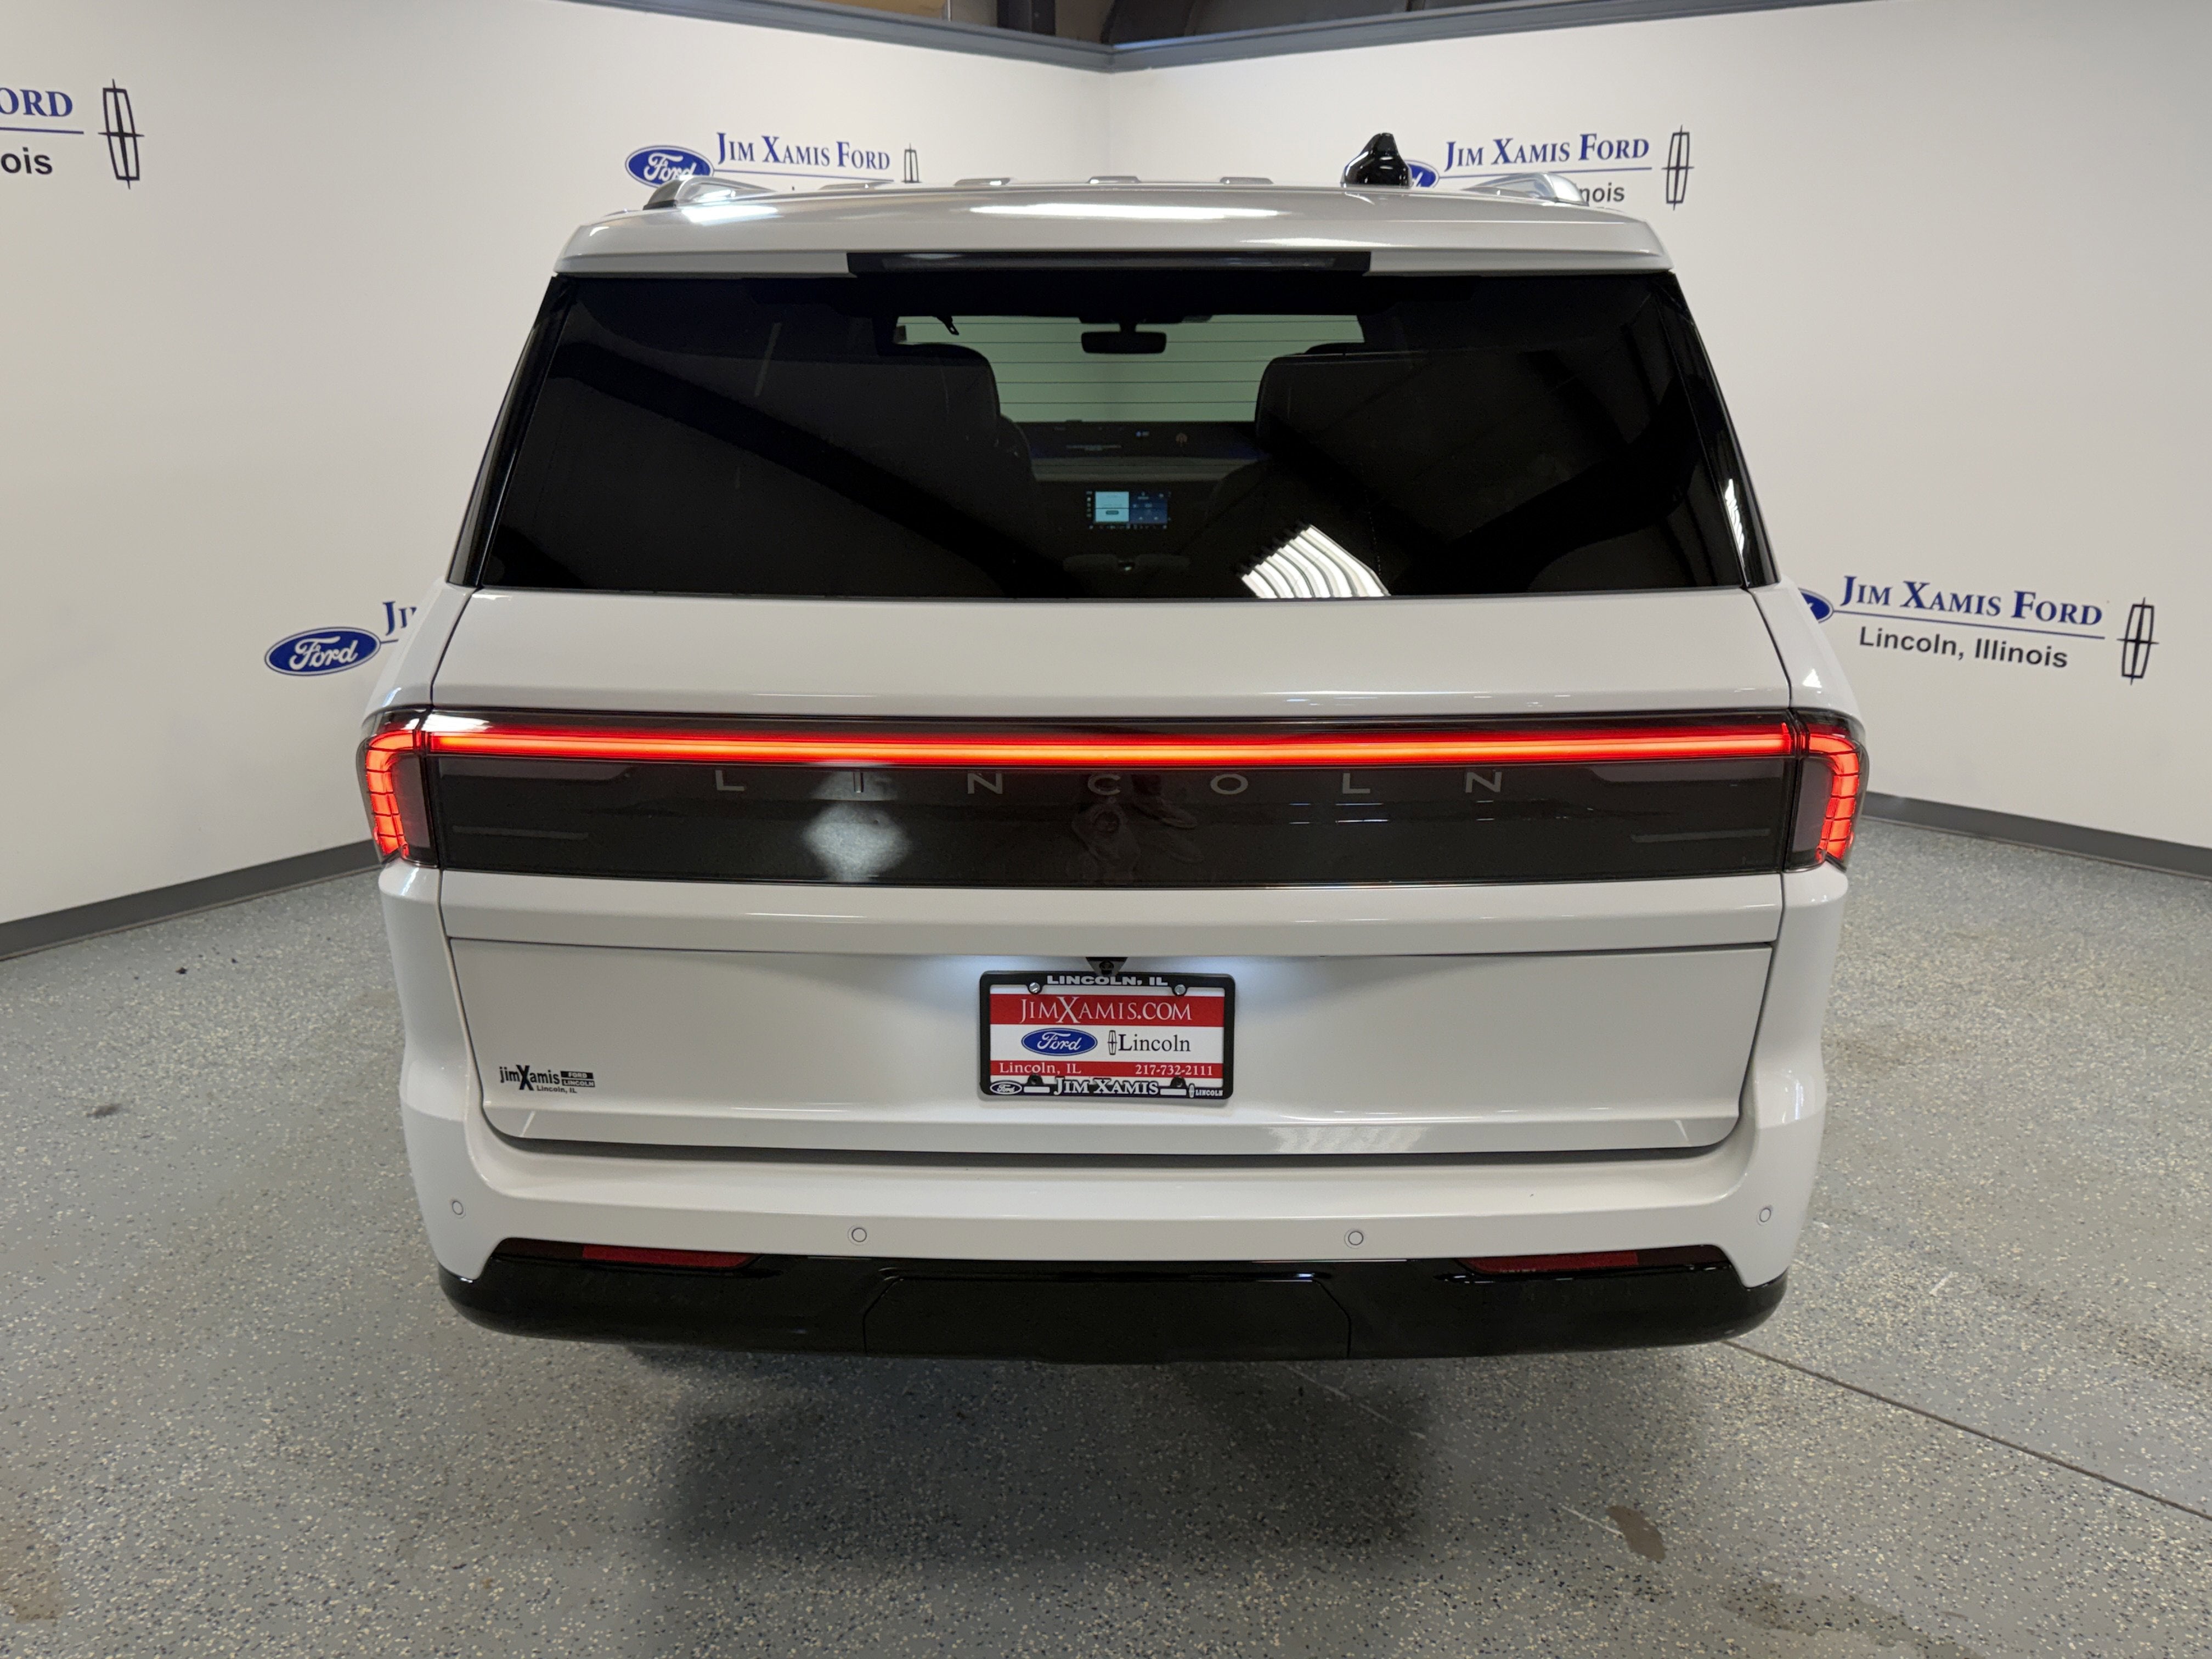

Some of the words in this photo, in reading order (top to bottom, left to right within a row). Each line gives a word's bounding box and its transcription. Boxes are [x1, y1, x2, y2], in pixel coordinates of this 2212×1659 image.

[0, 87, 73, 117] ORD
[716, 132, 754, 165] JIM
[761, 135, 831, 166] XAMIS
[836, 140, 890, 170] FORD
[1444, 141, 1484, 172] JIM
[1491, 138, 1571, 165] XAMIS
[1579, 133, 1650, 161] FORD
[644, 153, 697, 181] Ford
[1840, 575, 1892, 606] JIM
[1899, 580, 2001, 616] XAMIS
[2011, 590, 2102, 625] FORD
[289, 636, 358, 670] Ford
[1860, 626, 1965, 661] Lincoln,
[1975, 638, 2068, 668] Illinois
[715, 769, 1502, 795] LINCOLN
[1047, 975, 1143, 986] LINCOLN,
[1149, 977, 1168, 986] IL
[1037, 1032, 1082, 1052] Ford
[1118, 1034, 1191, 1052] Lincoln
[1000, 1062, 1060, 1075] Lincoln,
[1066, 1063, 1082, 1074] IL
[1135, 1064, 1213, 1076] 217-732-2111
[1053, 1076, 1090, 1096] JIM
[1094, 1078, 1159, 1096] XAMIS
